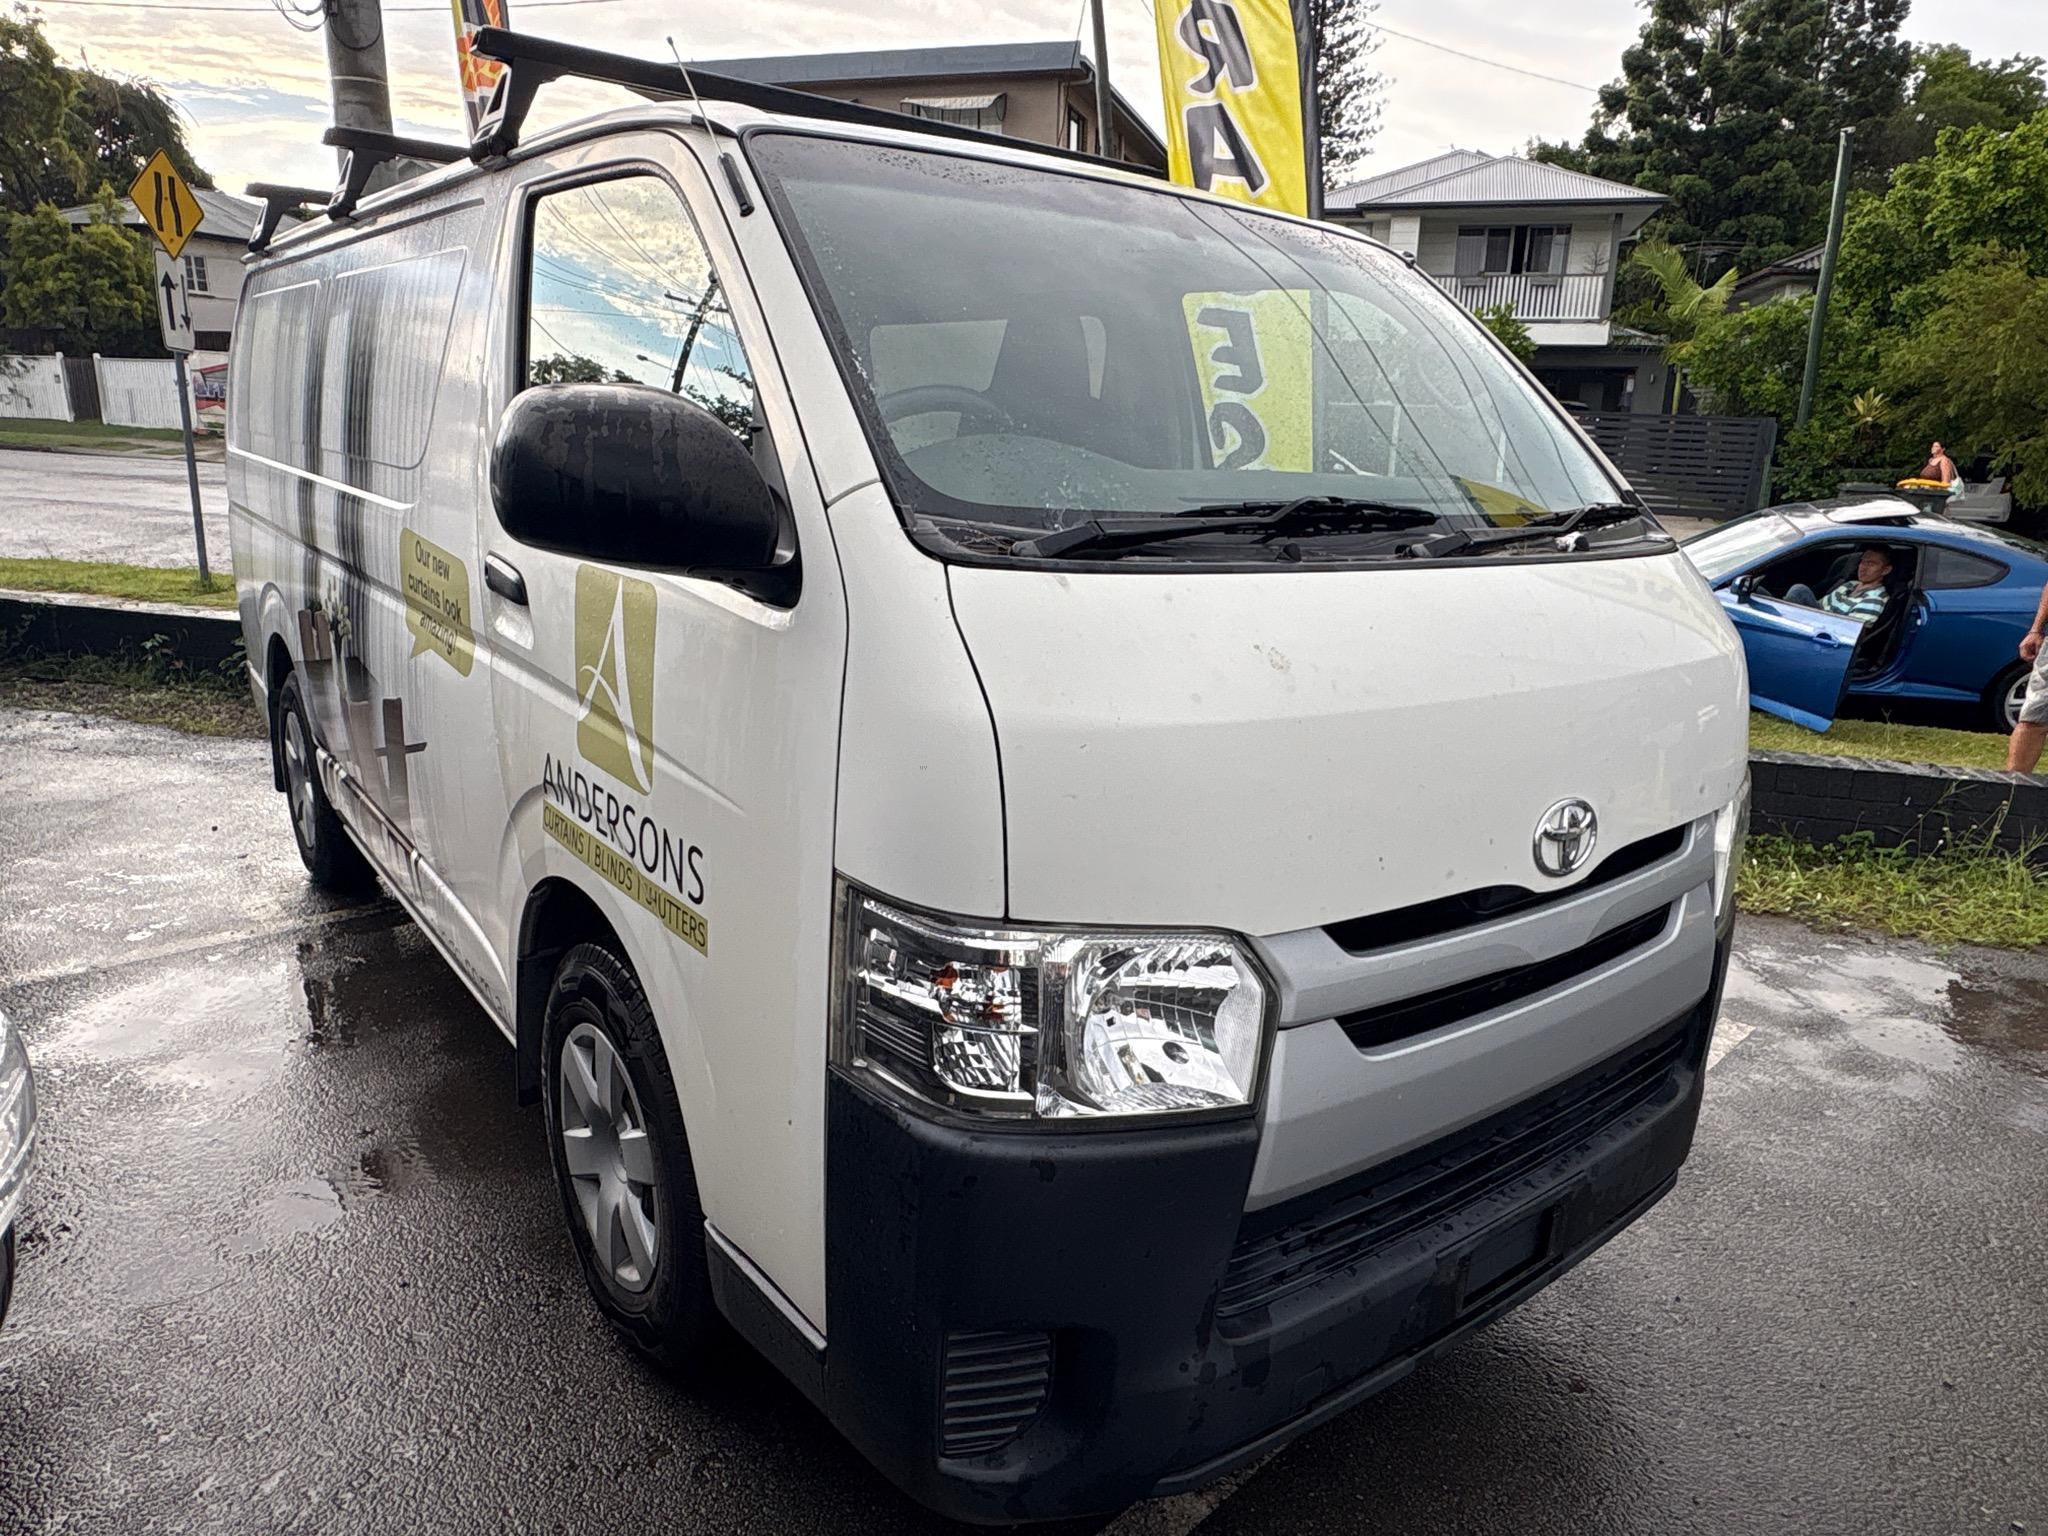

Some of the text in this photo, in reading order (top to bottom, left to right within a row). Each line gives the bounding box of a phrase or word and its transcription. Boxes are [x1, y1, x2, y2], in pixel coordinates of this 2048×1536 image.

[415, 540, 449, 581] Our new
[408, 573, 462, 625] curtains look
[420, 611, 457, 655] amazing!
[543, 752, 704, 905] ANDERSONS
[543, 805, 584, 855] CURTAINS
[594, 845, 633, 891] BLINDS
[644, 879, 706, 948] SHUTTERS
